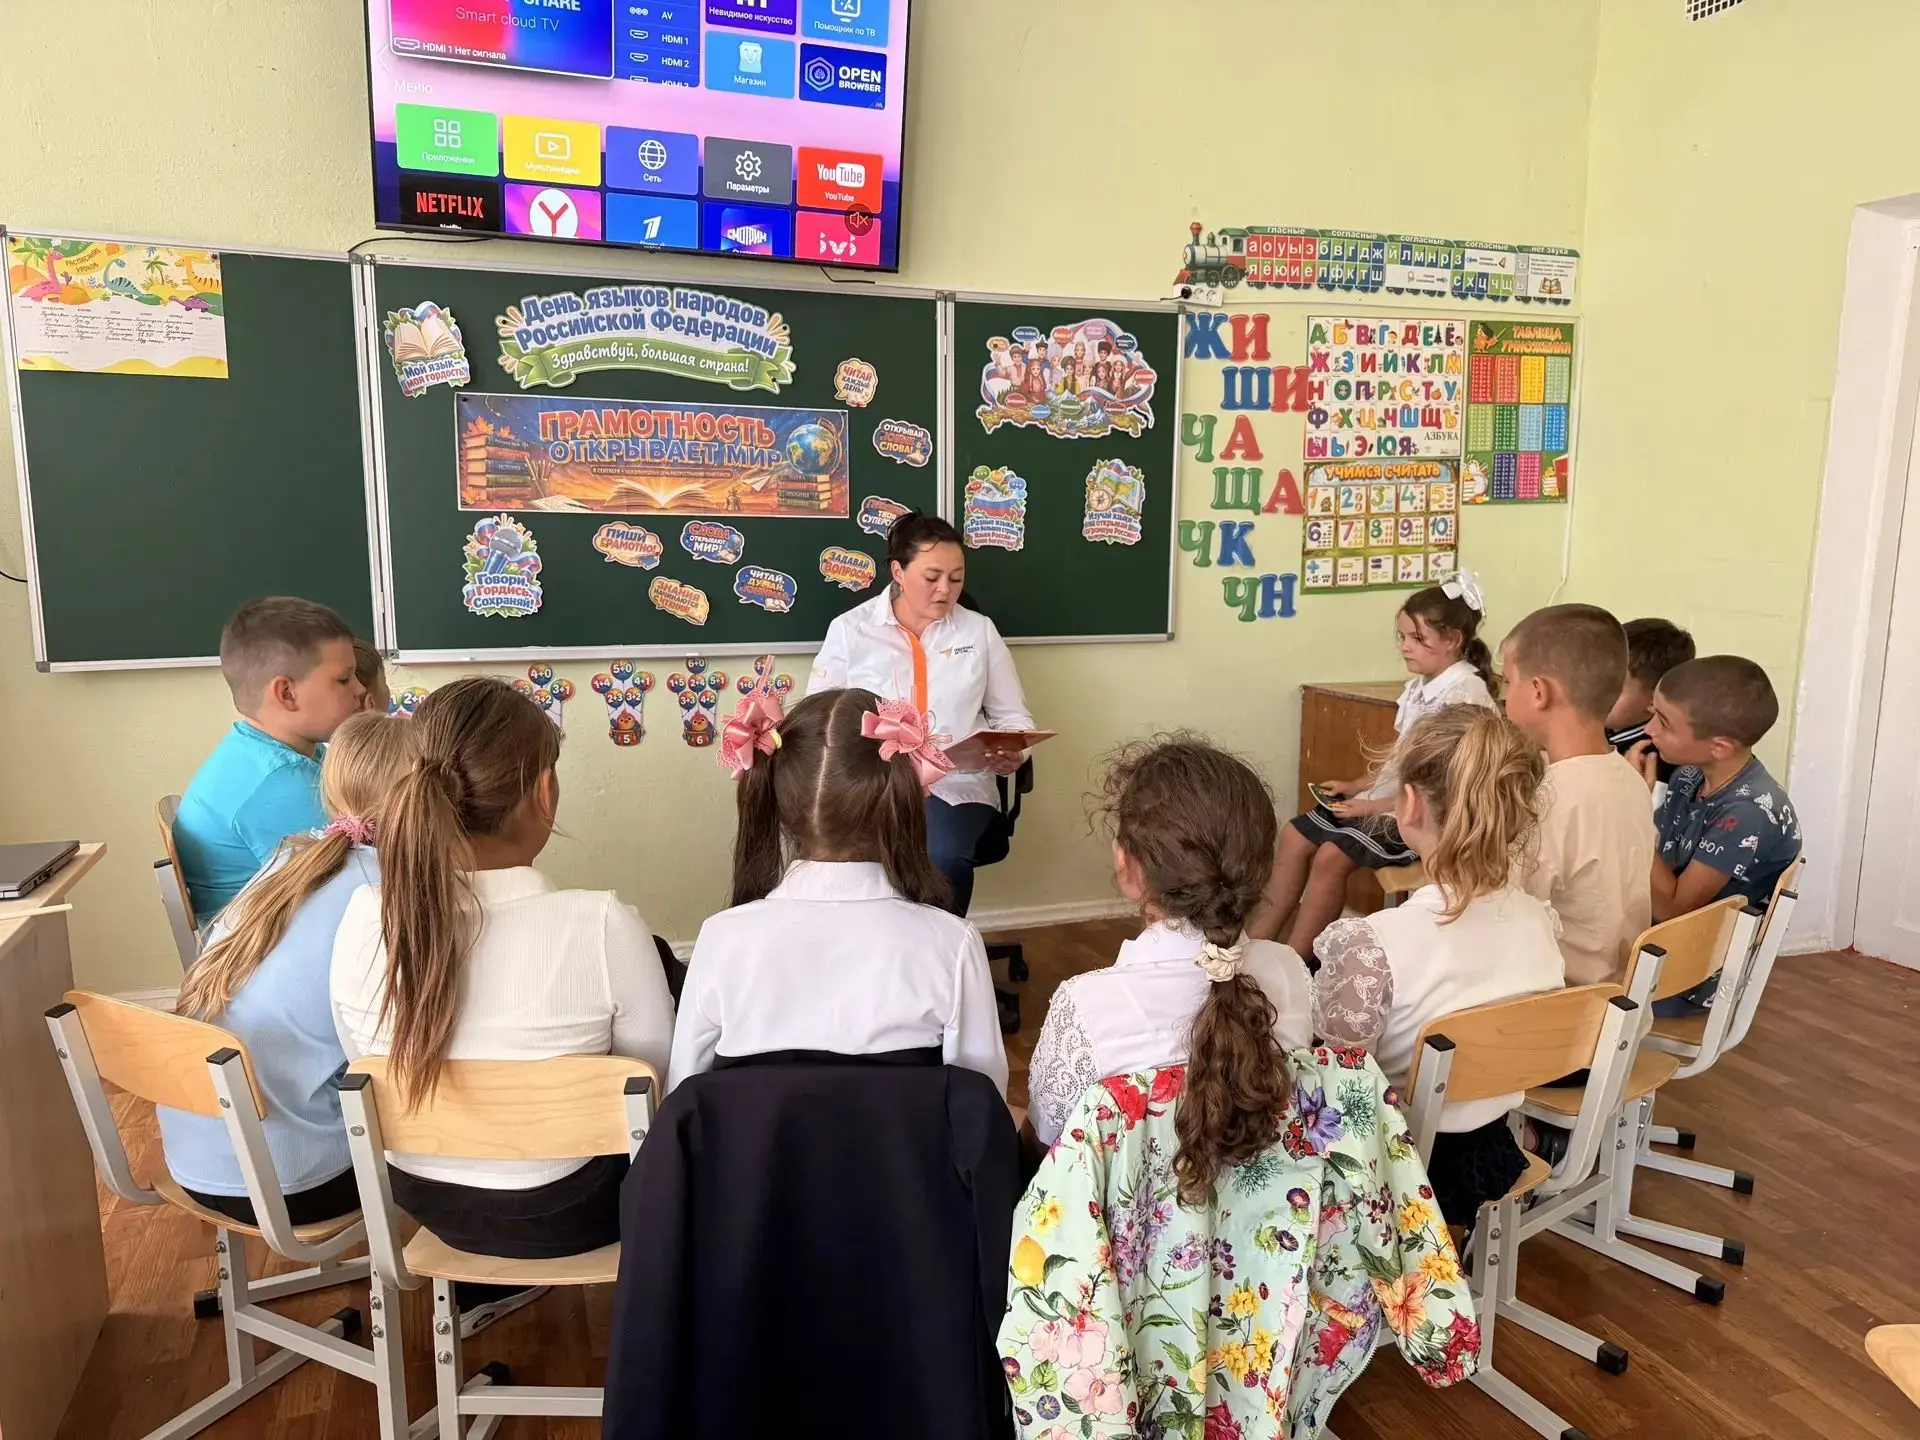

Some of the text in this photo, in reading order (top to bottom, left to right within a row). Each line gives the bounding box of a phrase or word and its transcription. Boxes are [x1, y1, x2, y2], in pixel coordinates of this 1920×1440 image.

[456, 7, 560, 31] Smart cloud TV
[661, 11, 673, 20] AV
[709, 7, 793, 26] Невидимое искусство
[814, 20, 876, 37] Помощник по ТВ
[661, 34, 689, 45] HDMI 1
[423, 42, 446, 53] HDMI
[455, 47, 471, 57] Нет
[472, 49, 506, 61] сигнала
[661, 57, 689, 68] HDMI 2
[734, 75, 767, 87] Магазин
[838, 65, 881, 83] OPEN
[394, 80, 433, 94] Меню
[838, 80, 881, 93] BROWSER
[421, 151, 475, 165] Приложения
[643, 172, 662, 184] Сеть
[726, 181, 770, 195] Параметры
[824, 191, 855, 202] YouTube
[416, 191, 485, 219] NETFLIX
[727, 225, 767, 246] СМОТРИМ
[1267, 227, 1306, 235] гласные
[1331, 230, 1378, 240] согласные
[819, 231, 857, 257] ivi
[1400, 234, 1445, 246] согласные
[1465, 240, 1508, 251] согласные
[1249, 241, 1314, 256] а о у ы э
[1531, 246, 1569, 256] нет звука
[522, 288, 768, 328] День языков народов
[515, 307, 777, 357] Российской Федерации
[1184, 312, 1271, 362] ЖИ
[1309, 323, 1455, 347] А Б В Г Д Е Ё
[551, 342, 749, 375] Здравствуй, большая страна!
[404, 360, 455, 379] Мой язык
[843, 365, 872, 382] ЧИТАЙ
[406, 377, 425, 389] моя
[842, 375, 870, 389] КАЖДЫЙ
[1220, 366, 1311, 412] ШИ
[538, 409, 776, 447] ГРАМОТНОСТЬ
[883, 423, 924, 439] ОТКРЫВАЙ
[1180, 413, 1263, 463] ЧА
[1424, 430, 1459, 441] АЗБУКА
[548, 438, 783, 469] ОТКРЫВАЕТ МИР
[880, 441, 914, 455] СЛОВА!
[1324, 463, 1441, 481] УЧИМСЯ СЧИТАТЬ
[1210, 466, 1307, 515] ЩА
[1309, 484, 1445, 509] 1 2 3 4 5
[1088, 511, 1111, 520] Изучай
[606, 528, 647, 543] ПИШИ
[689, 523, 731, 540] СЛОВА
[1308, 517, 1448, 541] 6 7 8 9 10
[600, 537, 657, 555] ГРАМОТНО!
[693, 541, 722, 553] МИР!
[1178, 520, 1256, 568] ЧК
[829, 551, 870, 569] ЗАДАВАЙ
[655, 580, 700, 602] ЗНАНИЯ
[1222, 572, 1298, 622] ЧН
[473, 596, 534, 610] Сохраняй!
[613, 663, 632, 673] 5+0
[688, 659, 705, 668] 6+0
[530, 669, 551, 679] 4+0
[634, 677, 650, 685] 4+1
[711, 676, 725, 685] 5+1
[552, 685, 570, 695] 3+1
[594, 679, 610, 688] 1+4
[670, 679, 685, 687] 1+5
[690, 679, 705, 687] 2+4
[739, 681, 753, 690] 1+6
[607, 693, 623, 703] 2+3
[626, 692, 642, 701] 3+2
[681, 696, 695, 704] 3+3
[700, 694, 715, 703] 4+2
[624, 735, 631, 744] 5
[697, 735, 703, 744] 6
